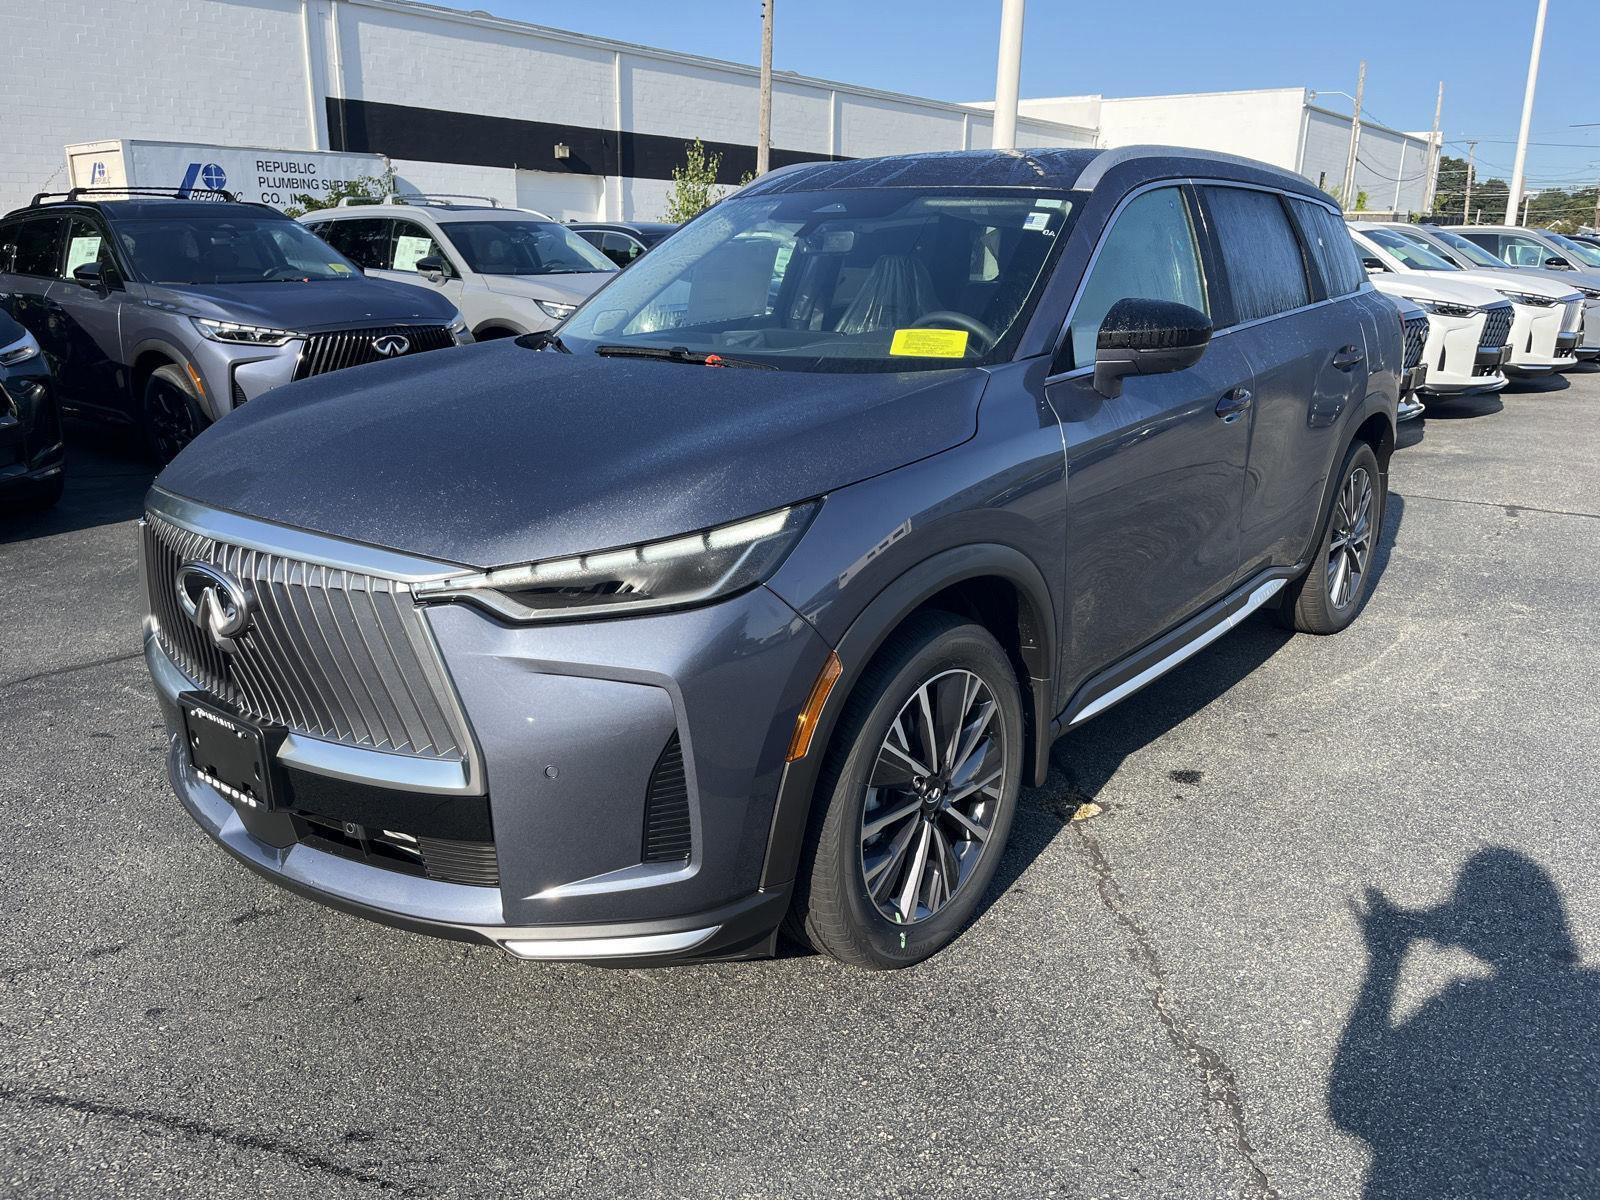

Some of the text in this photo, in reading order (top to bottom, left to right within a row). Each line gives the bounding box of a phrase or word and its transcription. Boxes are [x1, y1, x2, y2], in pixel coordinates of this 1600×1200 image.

[256, 160, 316, 174] REPUBLIC
[258, 176, 351, 191] PLUMBING SUPP
[191, 190, 243, 202] REPUBIC
[261, 192, 286, 206] CO.,
